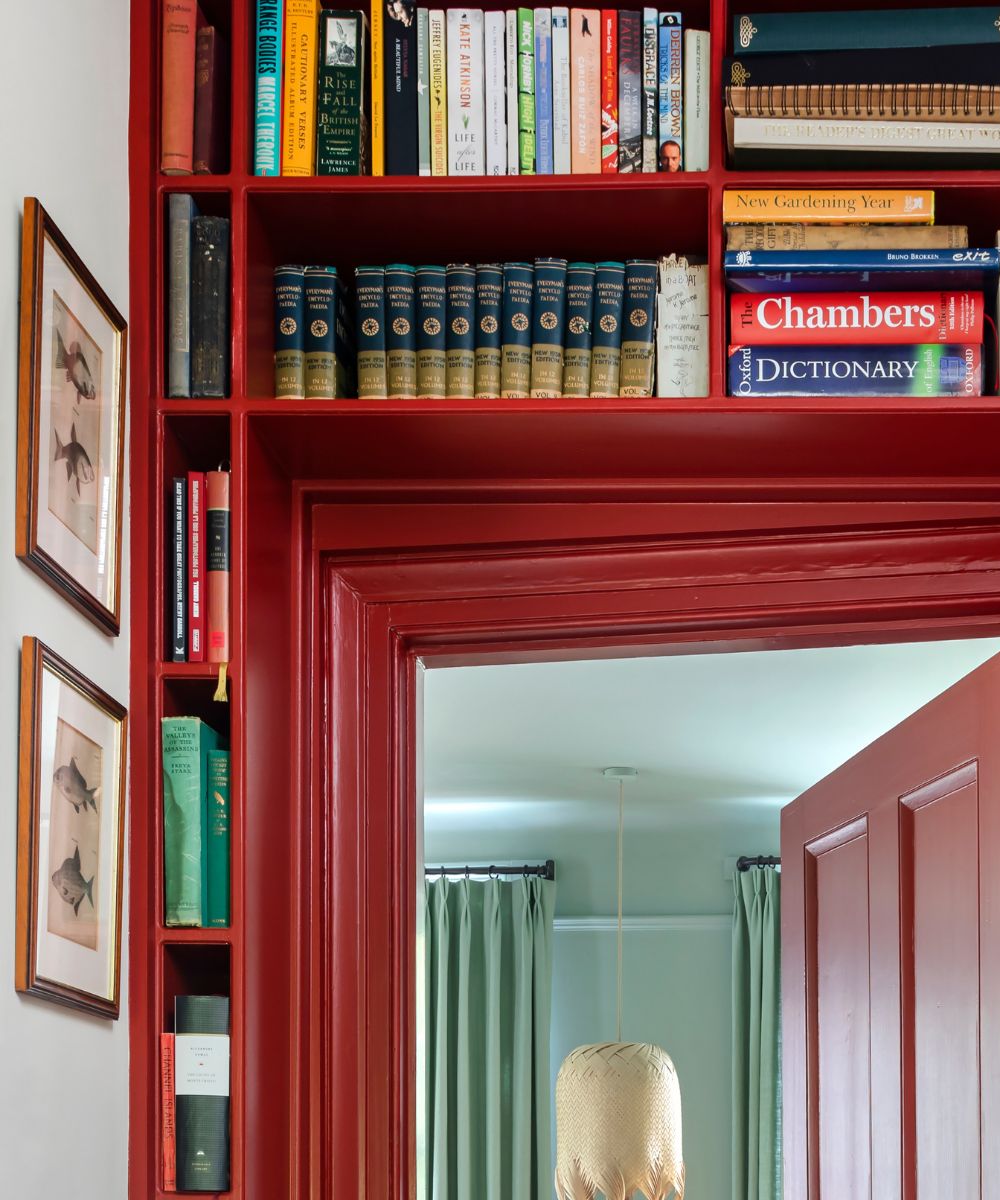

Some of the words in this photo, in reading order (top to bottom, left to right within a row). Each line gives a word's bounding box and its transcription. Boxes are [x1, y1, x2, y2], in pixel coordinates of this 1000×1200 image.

[431, 20, 442, 46] JEFFREY
[459, 23, 471, 50] KATE
[259, 35, 277, 74] BODIES
[299, 33, 309, 105] CAUTIONARY
[432, 48, 442, 89] EUGENIDES
[644, 28, 656, 88] DISGRACE
[670, 29, 680, 84] DERREN
[325, 76, 357, 89] RISE
[459, 54, 472, 108] ATKINSON
[521, 52, 533, 95] HORNBY
[257, 77, 276, 118] MARCEL
[323, 93, 357, 106] FALL
[670, 90, 680, 138] BROWN
[298, 111, 308, 151] VERSES
[320, 113, 359, 126] BRITISH
[323, 126, 356, 137] EMPIRE
[256, 121, 275, 170] THEROUX
[454, 133, 476, 143] LIFE
[320, 158, 357, 166] LAWRENCE
[455, 162, 477, 172] LIFE
[737, 194, 770, 209] New
[774, 193, 856, 213] Gardening
[861, 195, 895, 209] Year
[887, 253, 909, 261] BRUNO
[952, 248, 990, 262] exit
[305, 288, 333, 296] EVERYMAN'S
[625, 277, 655, 285] EVERYMAN'S
[741, 301, 753, 329] The
[756, 295, 936, 330] Chambers
[739, 347, 752, 395] Oxford
[756, 357, 920, 382] DICTIONARY
[922, 349, 934, 381] English
[965, 348, 974, 393] OXFORD
